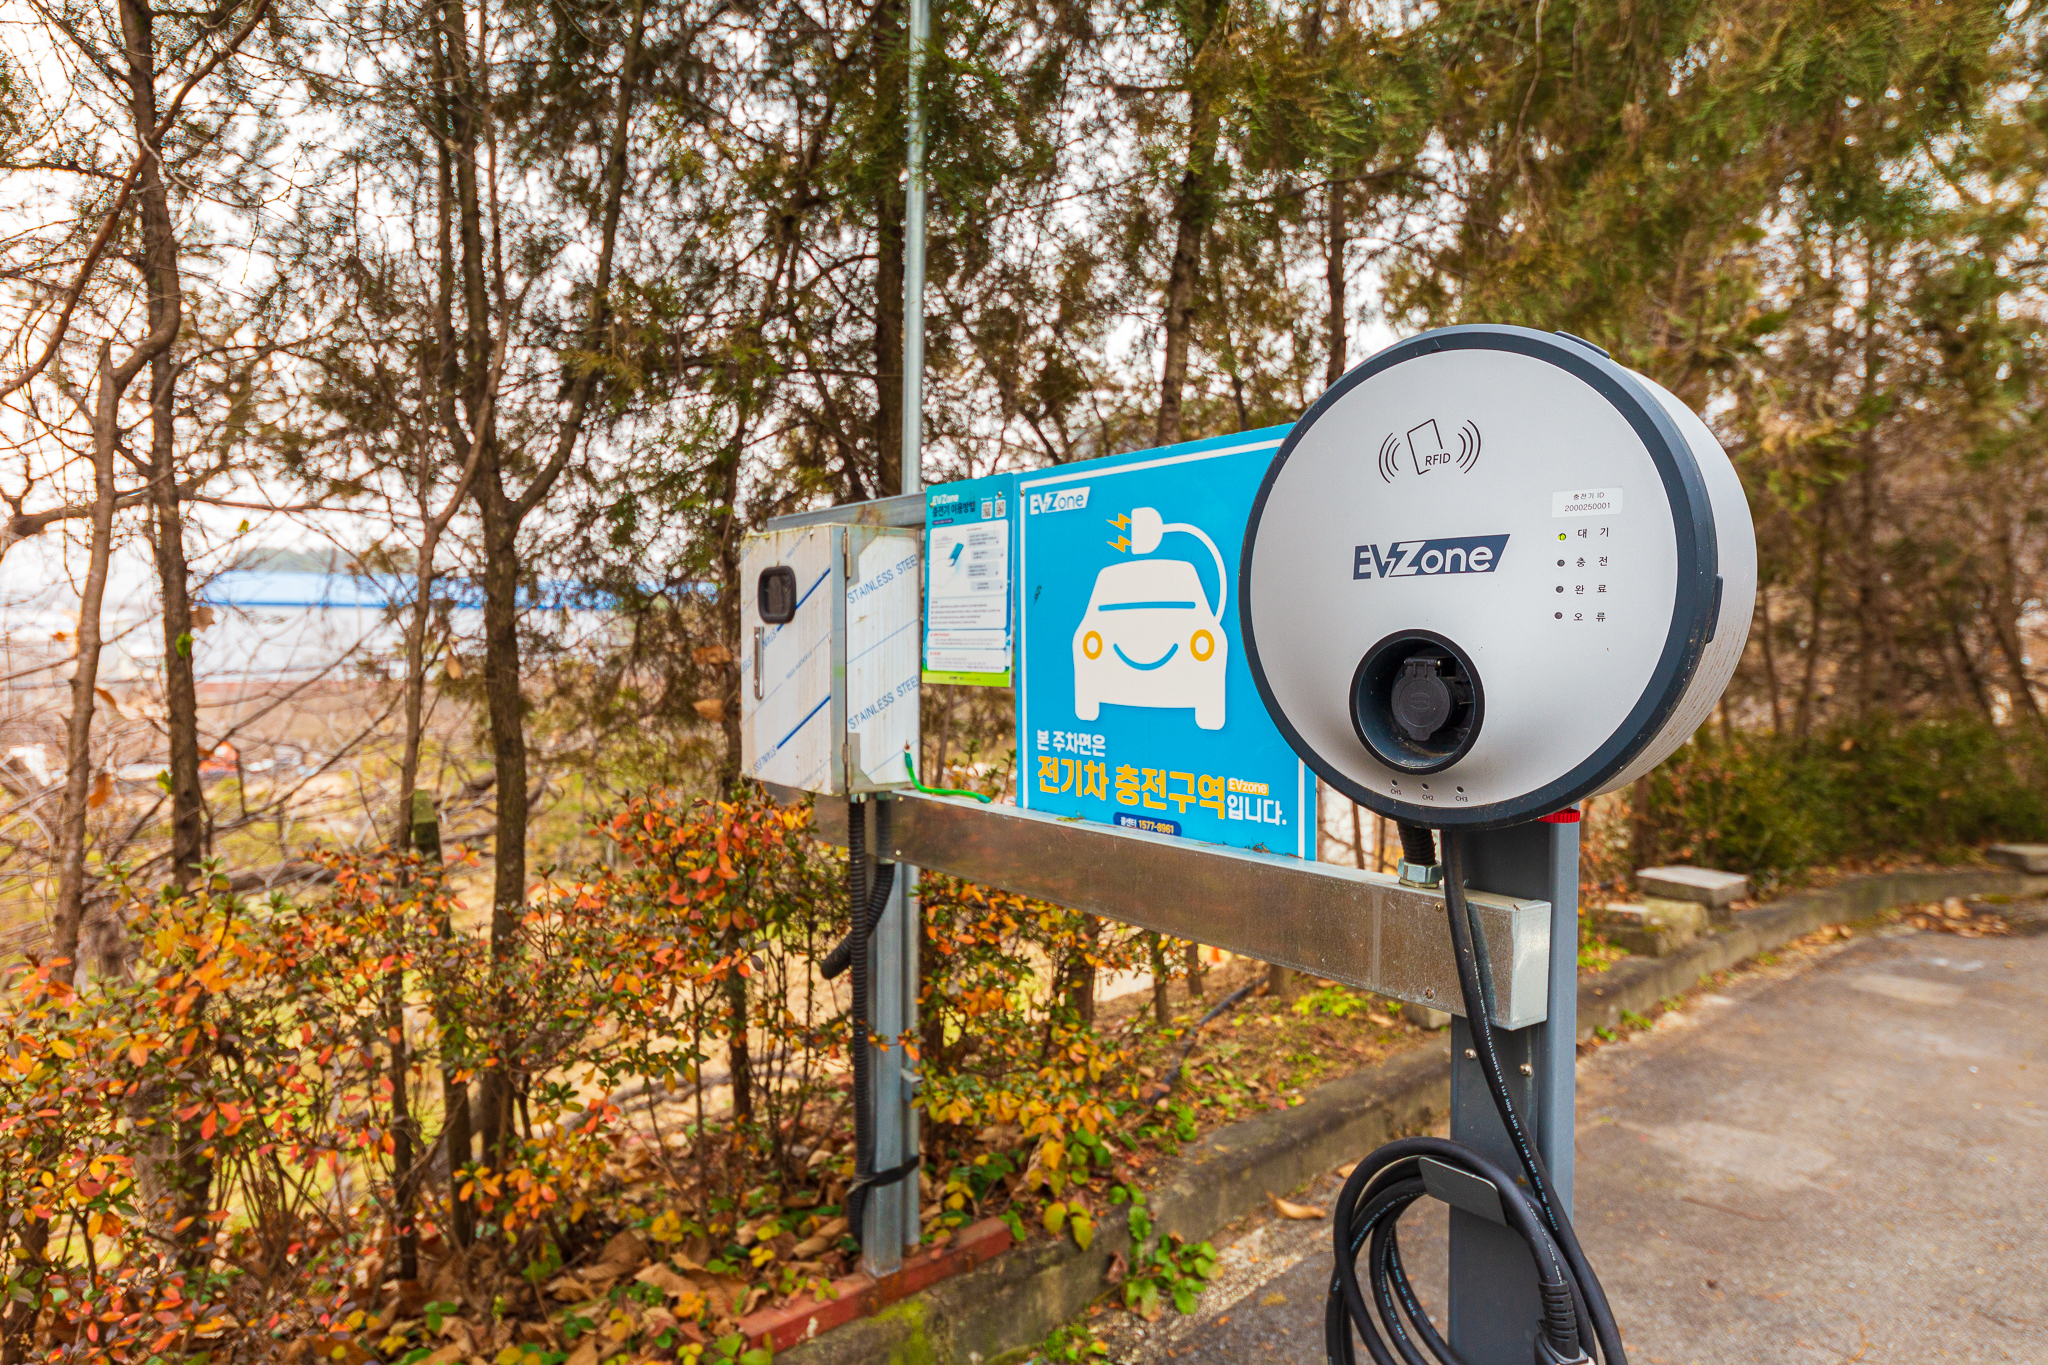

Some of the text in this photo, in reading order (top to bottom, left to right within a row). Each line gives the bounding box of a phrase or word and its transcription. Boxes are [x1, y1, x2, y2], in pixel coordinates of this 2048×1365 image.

[1425, 452, 1451, 467] RFID
[932, 494, 959, 506] EVZone
[1030, 492, 1085, 516] EVZone
[1564, 502, 1611, 512] 2000250001
[1573, 491, 1605, 501] 충전기 ID
[1353, 541, 1494, 580] EVZone
[847, 569, 894, 604] STAINLESS
[848, 692, 895, 730] STAINLESS
[1037, 729, 1106, 757] 본 주차면은
[1038, 756, 1225, 820] 전기차 충전구역
[1228, 777, 1268, 794] EVzone
[1227, 794, 1287, 826] 입니다.
[1138, 819, 1175, 835] 1577-8961
